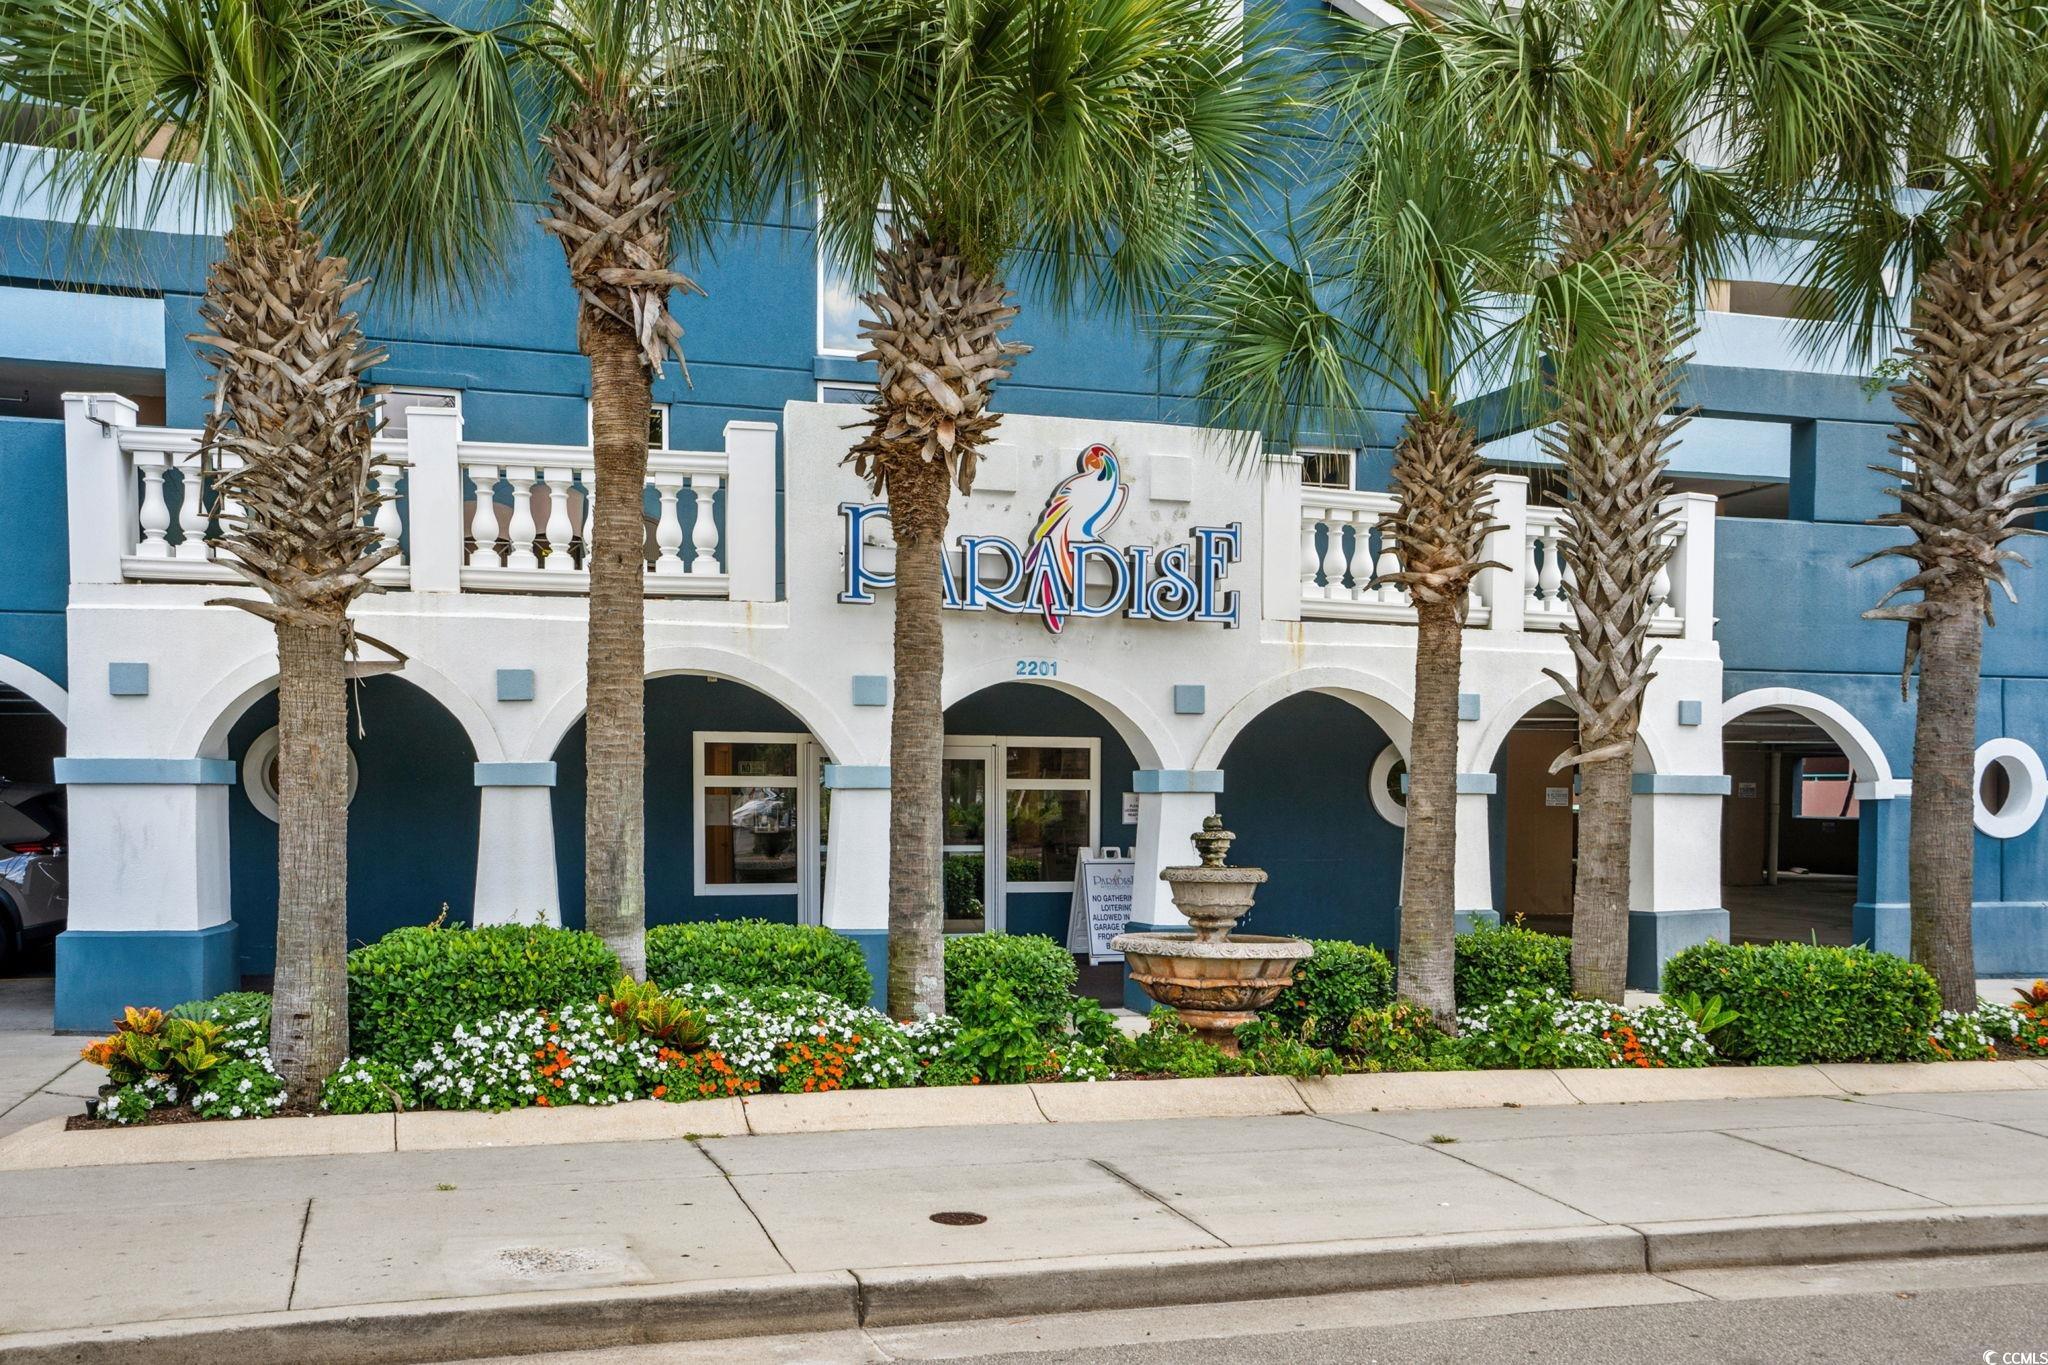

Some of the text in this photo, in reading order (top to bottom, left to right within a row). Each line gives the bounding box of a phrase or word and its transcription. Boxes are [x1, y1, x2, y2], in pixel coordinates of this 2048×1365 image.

[1016, 660, 1057, 676] 2201
[1092, 894, 1102, 902] NO
[1094, 923, 1120, 931] GARAGE
